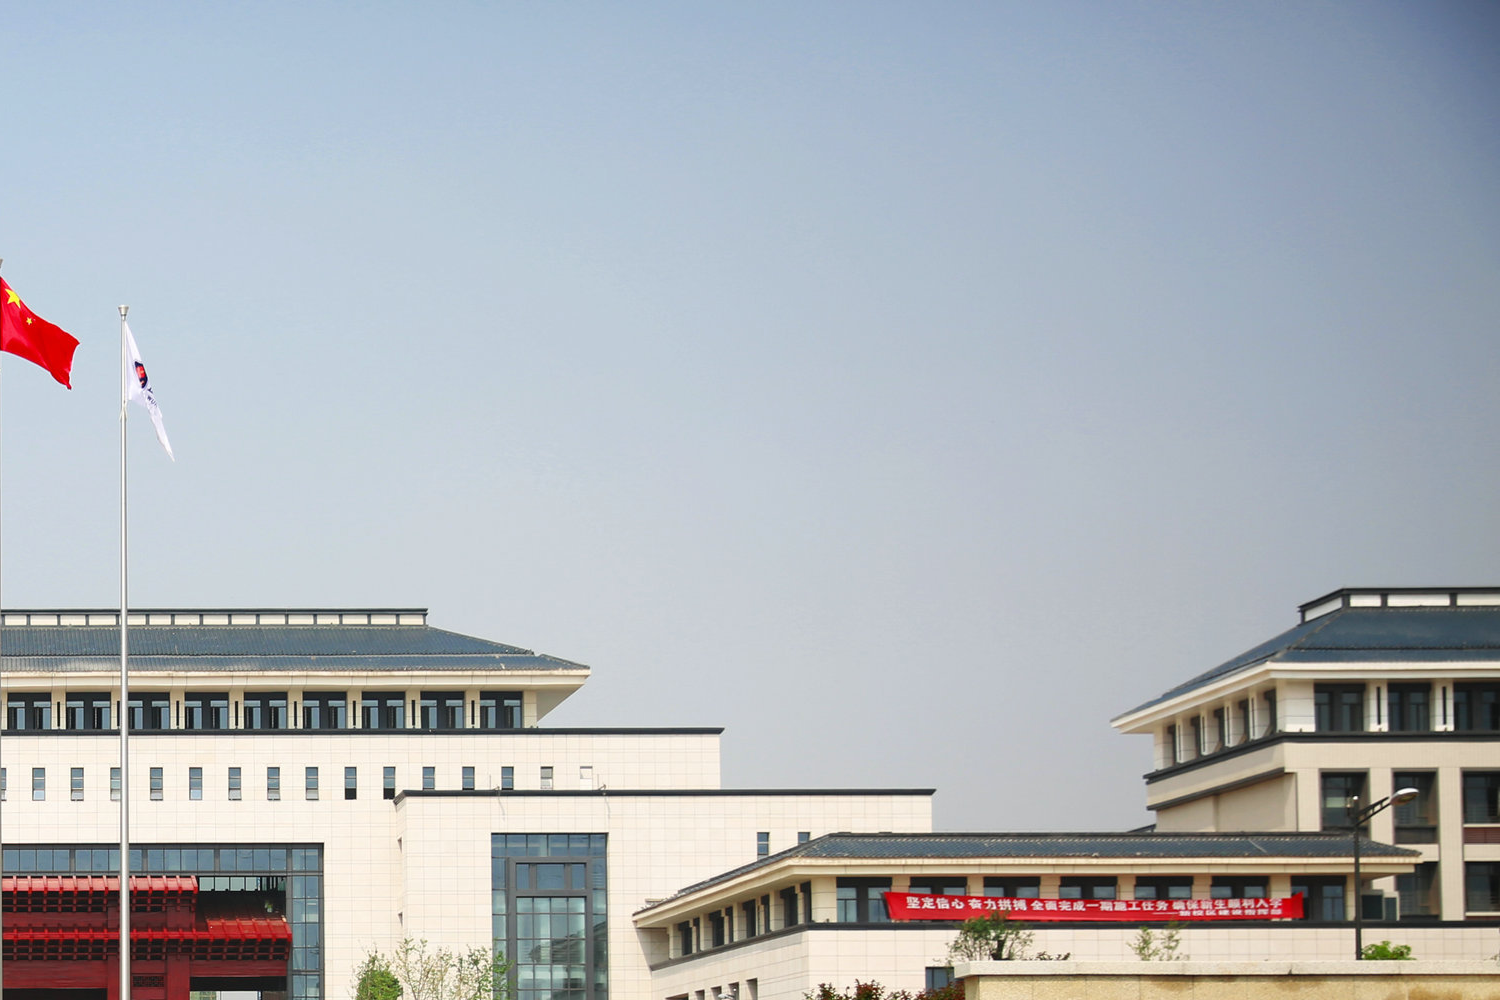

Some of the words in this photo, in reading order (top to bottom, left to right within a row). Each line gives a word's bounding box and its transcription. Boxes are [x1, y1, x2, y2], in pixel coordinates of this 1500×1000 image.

[905, 895, 966, 910] 坚定信心
[967, 897, 1028, 912] 奋力拼搏
[1030, 899, 1170, 912] 全面完成一期施工任务
[1171, 897, 1283, 910] 确保新生顺利入学
